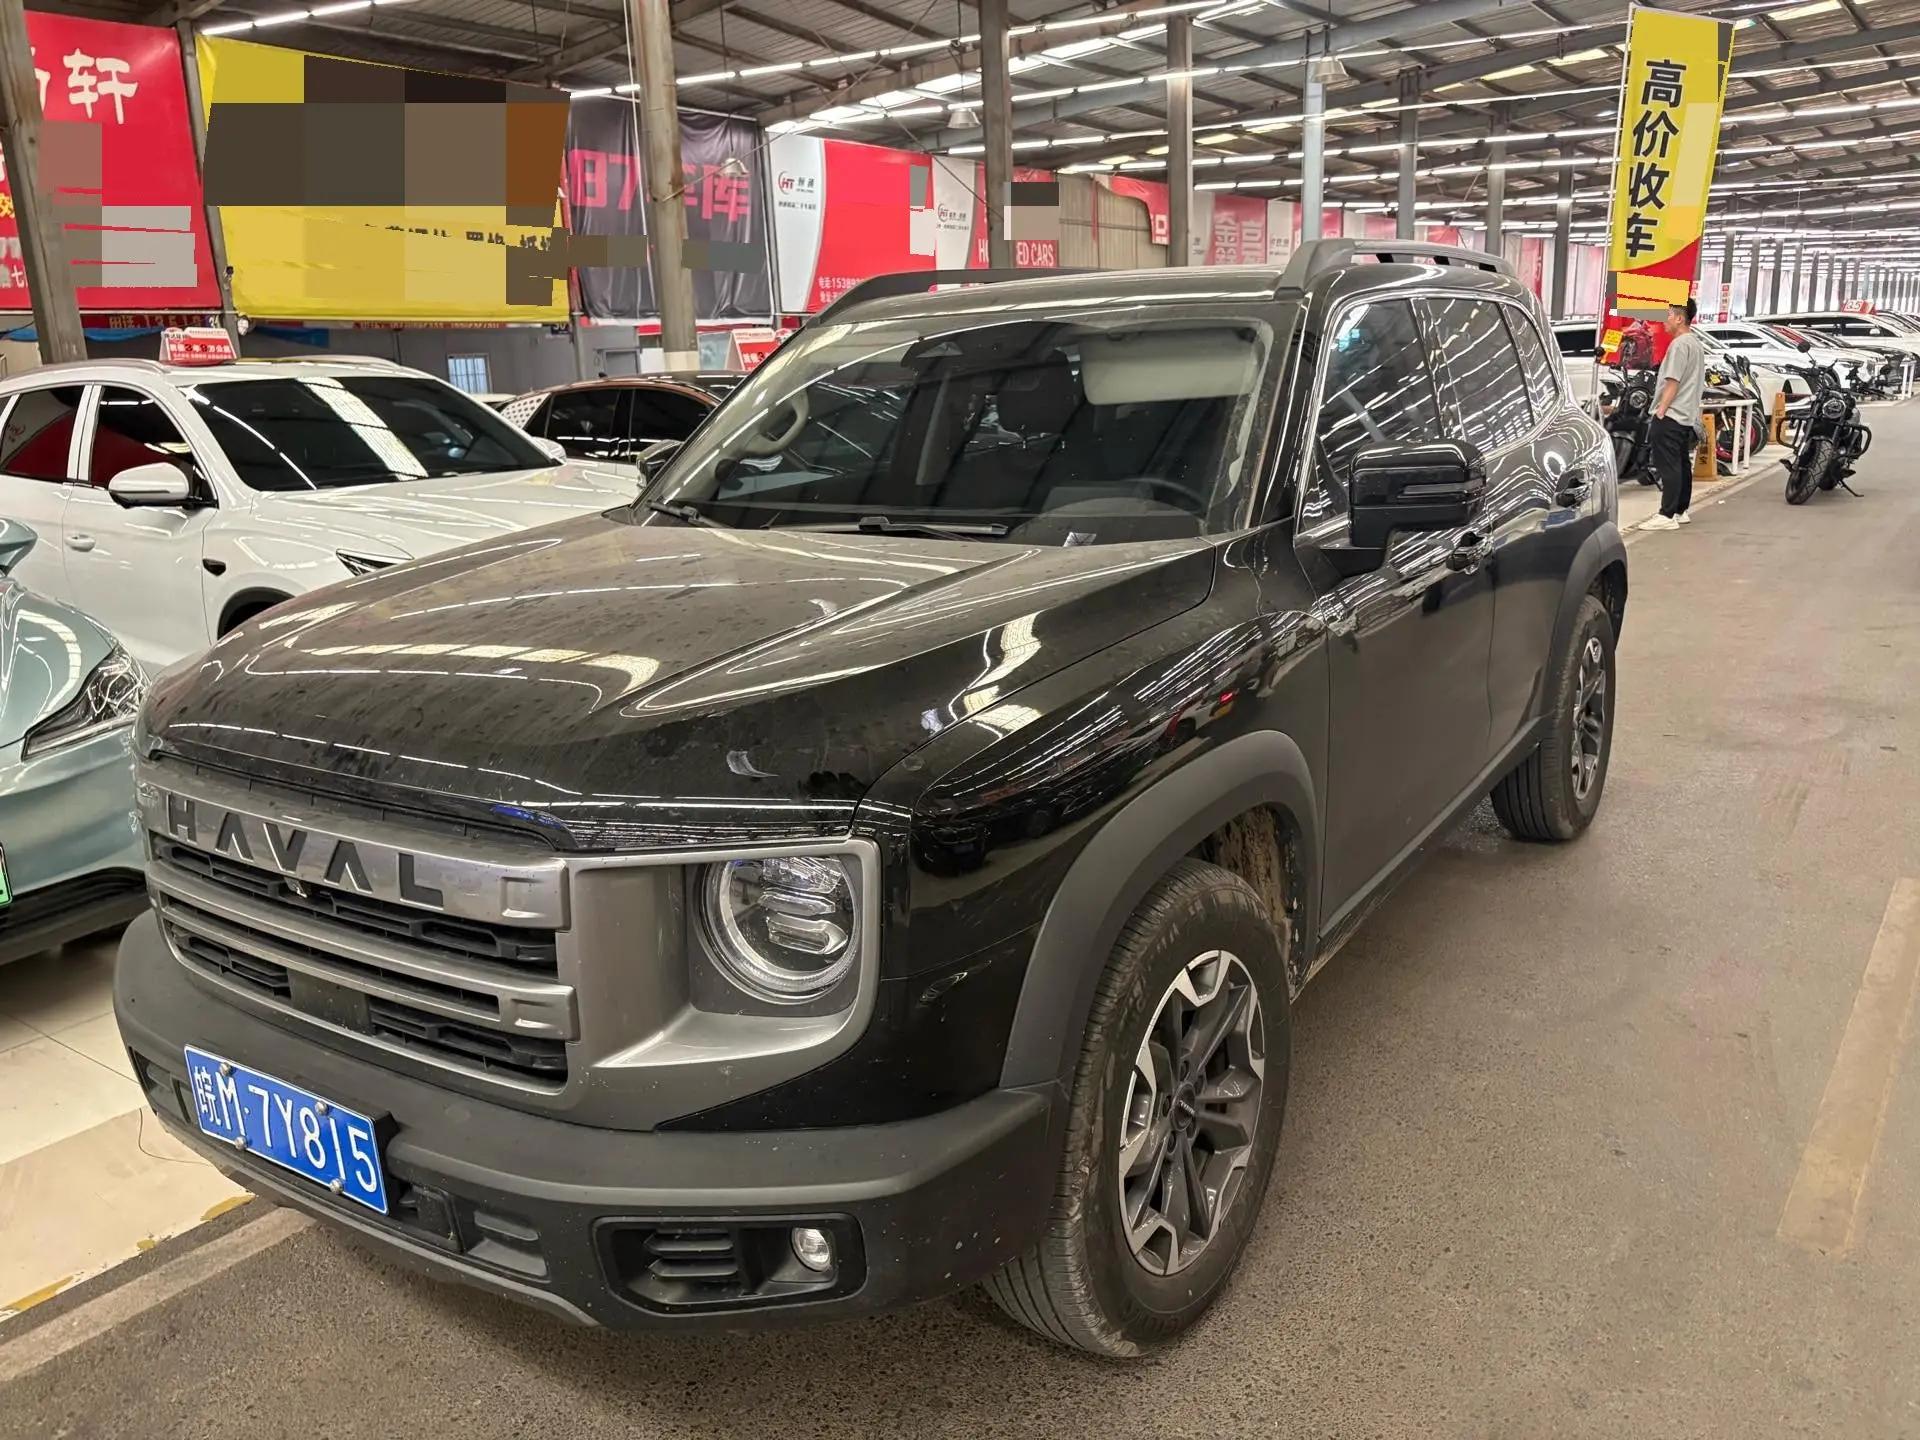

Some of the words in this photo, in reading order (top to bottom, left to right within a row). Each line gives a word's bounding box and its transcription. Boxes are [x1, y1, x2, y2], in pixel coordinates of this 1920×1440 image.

[1626, 59, 1687, 257] 高价收车
[1031, 243, 1054, 267] CARS
[166, 792, 444, 910] HAVAL
